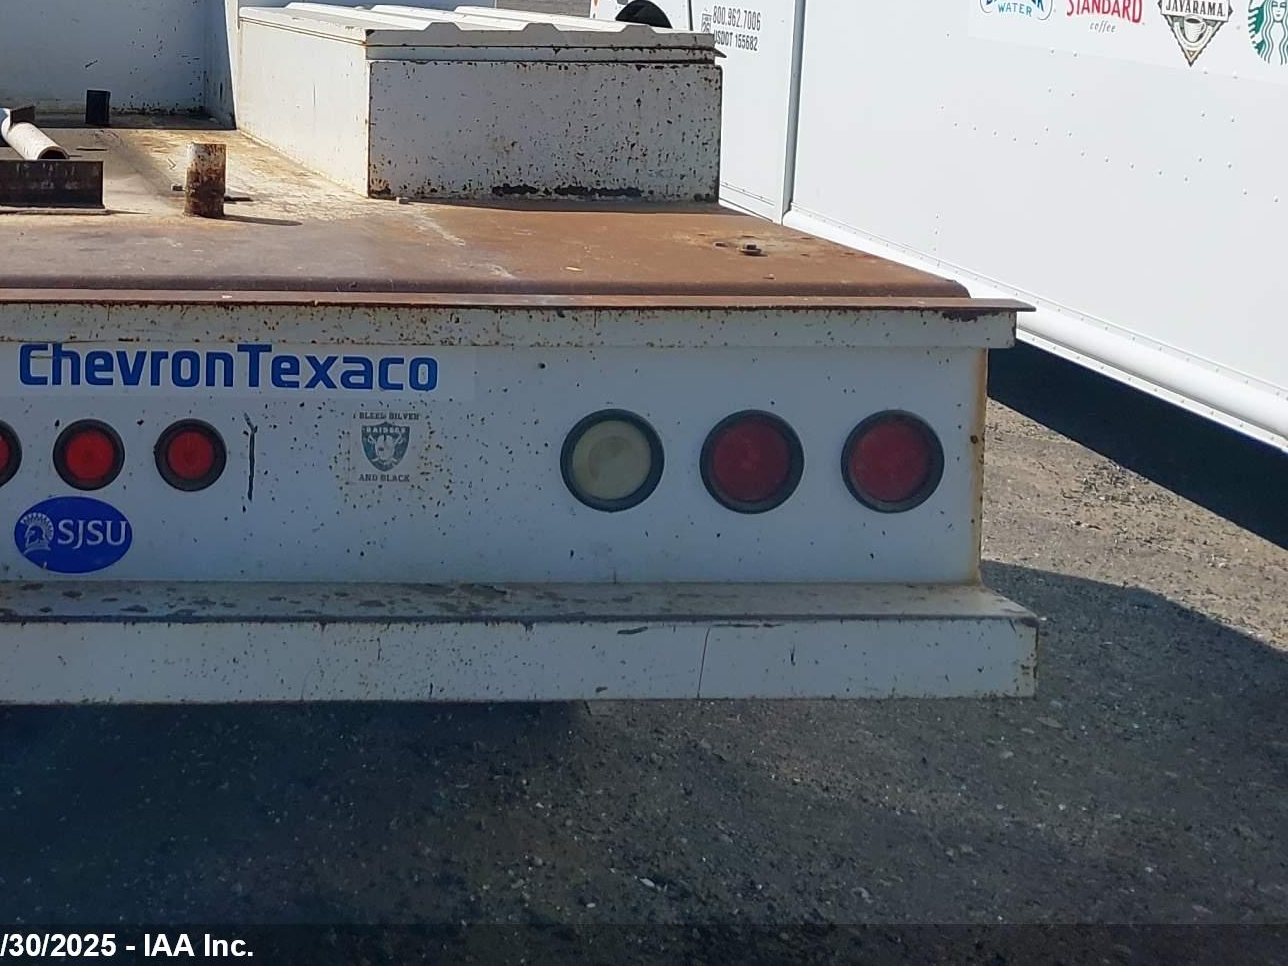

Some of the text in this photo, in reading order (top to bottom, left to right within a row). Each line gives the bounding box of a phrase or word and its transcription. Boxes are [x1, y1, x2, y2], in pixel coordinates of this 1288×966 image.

[712, 5, 761, 31] 800.962.7006
[998, 1, 1033, 17] WATER
[1089, 20, 1116, 34] coffee
[714, 30, 758, 51] USDOT 155682
[19, 342, 439, 392] ChevronTexaco
[359, 473, 410, 483] AND BLACK
[57, 519, 128, 549] SJSU
